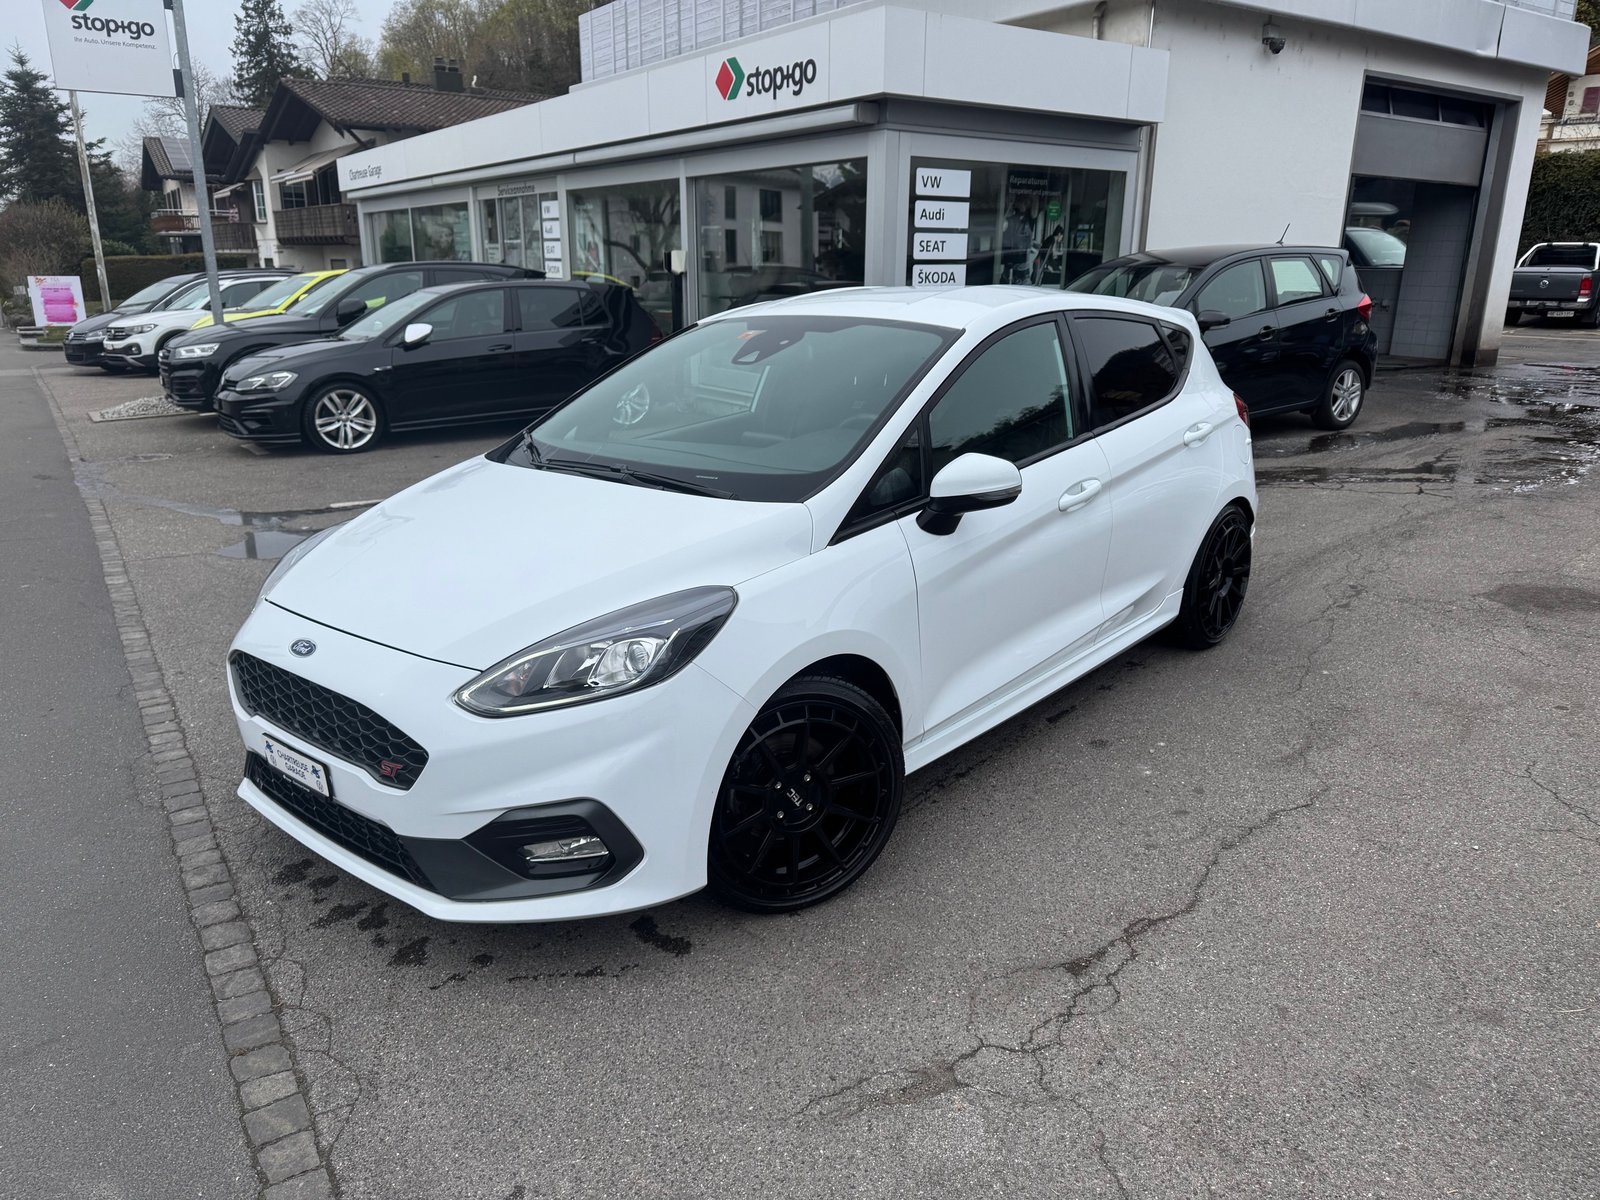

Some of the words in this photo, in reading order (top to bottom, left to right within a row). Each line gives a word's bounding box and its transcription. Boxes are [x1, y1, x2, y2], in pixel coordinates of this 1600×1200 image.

[71, 13, 155, 40] stop+go
[100, 39, 122, 47] Unsere
[746, 58, 817, 100] stop+go
[921, 175, 942, 189] VW
[1009, 175, 1048, 186] Reparaturen
[919, 207, 945, 221] Audi
[919, 240, 947, 253] SEAT
[917, 269, 956, 285] ŠKODA
[380, 759, 403, 777] ST
[786, 788, 804, 807] TEC
